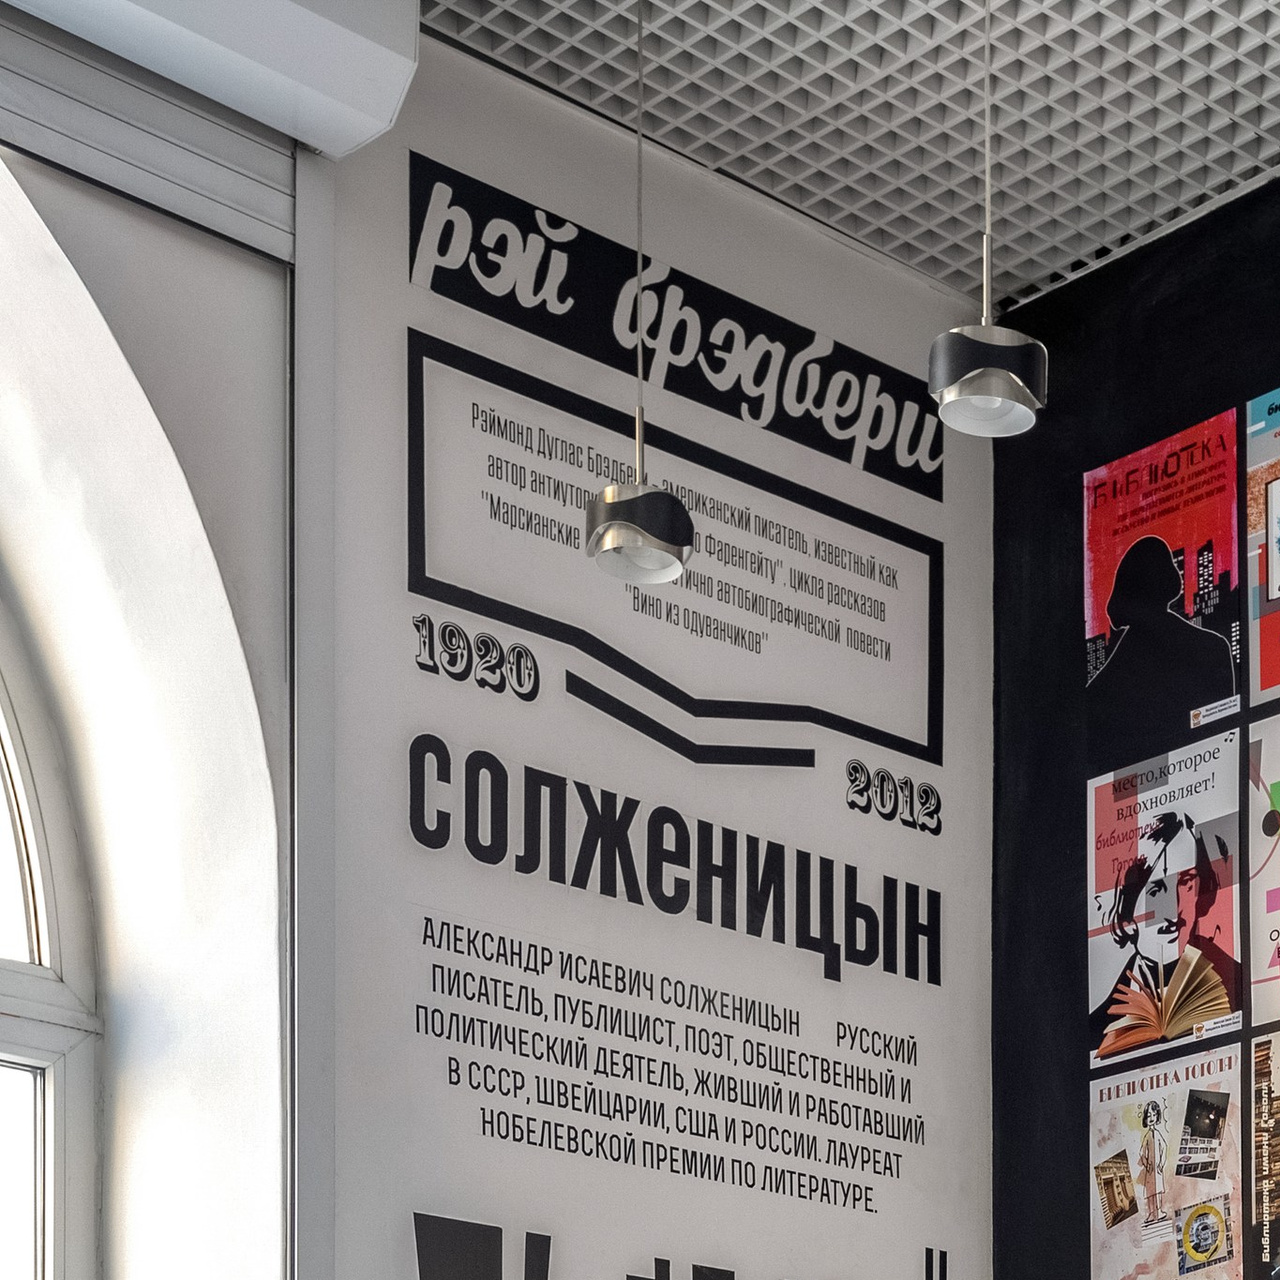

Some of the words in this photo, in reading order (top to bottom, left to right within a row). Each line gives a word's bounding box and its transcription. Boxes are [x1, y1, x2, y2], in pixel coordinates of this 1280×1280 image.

[411, 181, 576, 314] рэй
[612, 264, 944, 472] брэдбери
[471, 402, 533, 457] Рэймонд
[537, 428, 583, 469] Дуглас
[488, 454, 526, 491] автор
[754, 515, 811, 557] писатель,
[815, 538, 875, 583] известный
[717, 580, 840, 643] автобиографической
[847, 627, 890, 662] повести
[790, 567, 823, 599] цикла
[828, 580, 885, 622] рассказов
[412, 612, 541, 702] 1920
[845, 758, 942, 836] 2012
[1116, 771, 1216, 822] вдохновляет!
[423, 917, 553, 978] АЛЕКСАНДР
[559, 951, 655, 1001] ИСАЕВИЧ
[660, 976, 800, 1037] СОЛЖЕНИЦЫН
[837, 1021, 918, 1066] РУССКИЙ
[432, 964, 548, 1022] ПИСАТЕЛЬ,
[553, 993, 680, 1052] ПУБЛИЦИСТ,
[684, 1024, 738, 1066] ПОЭТ,
[743, 1038, 896, 1100] ОБЩЕСТВЕННЫЙ
[415, 1004, 587, 1071] ПОЛИТИЧЕСКИЙ
[594, 1049, 690, 1097] ДЕЯТЕЛЬ,
[694, 1069, 783, 1114] ЖИВШИЙ
[806, 1099, 925, 1146] РАБОТАВШИЙ
[1099, 1070, 1182, 1103] БИБЛИОТЕКА
[469, 1061, 531, 1106] СССР,
[536, 1073, 671, 1133] ШВЕЙЦАРИИ,
[676, 1108, 719, 1142] США
[741, 1119, 822, 1164] РОССИИ.
[827, 1139, 902, 1178] ЛАУРЕАТ
[480, 1107, 636, 1166] НОБЕЛЕВСКОЙ
[642, 1141, 725, 1185] ПРЕМИИ
[762, 1164, 878, 1214] ЛИТЕРАТУРЕ.
